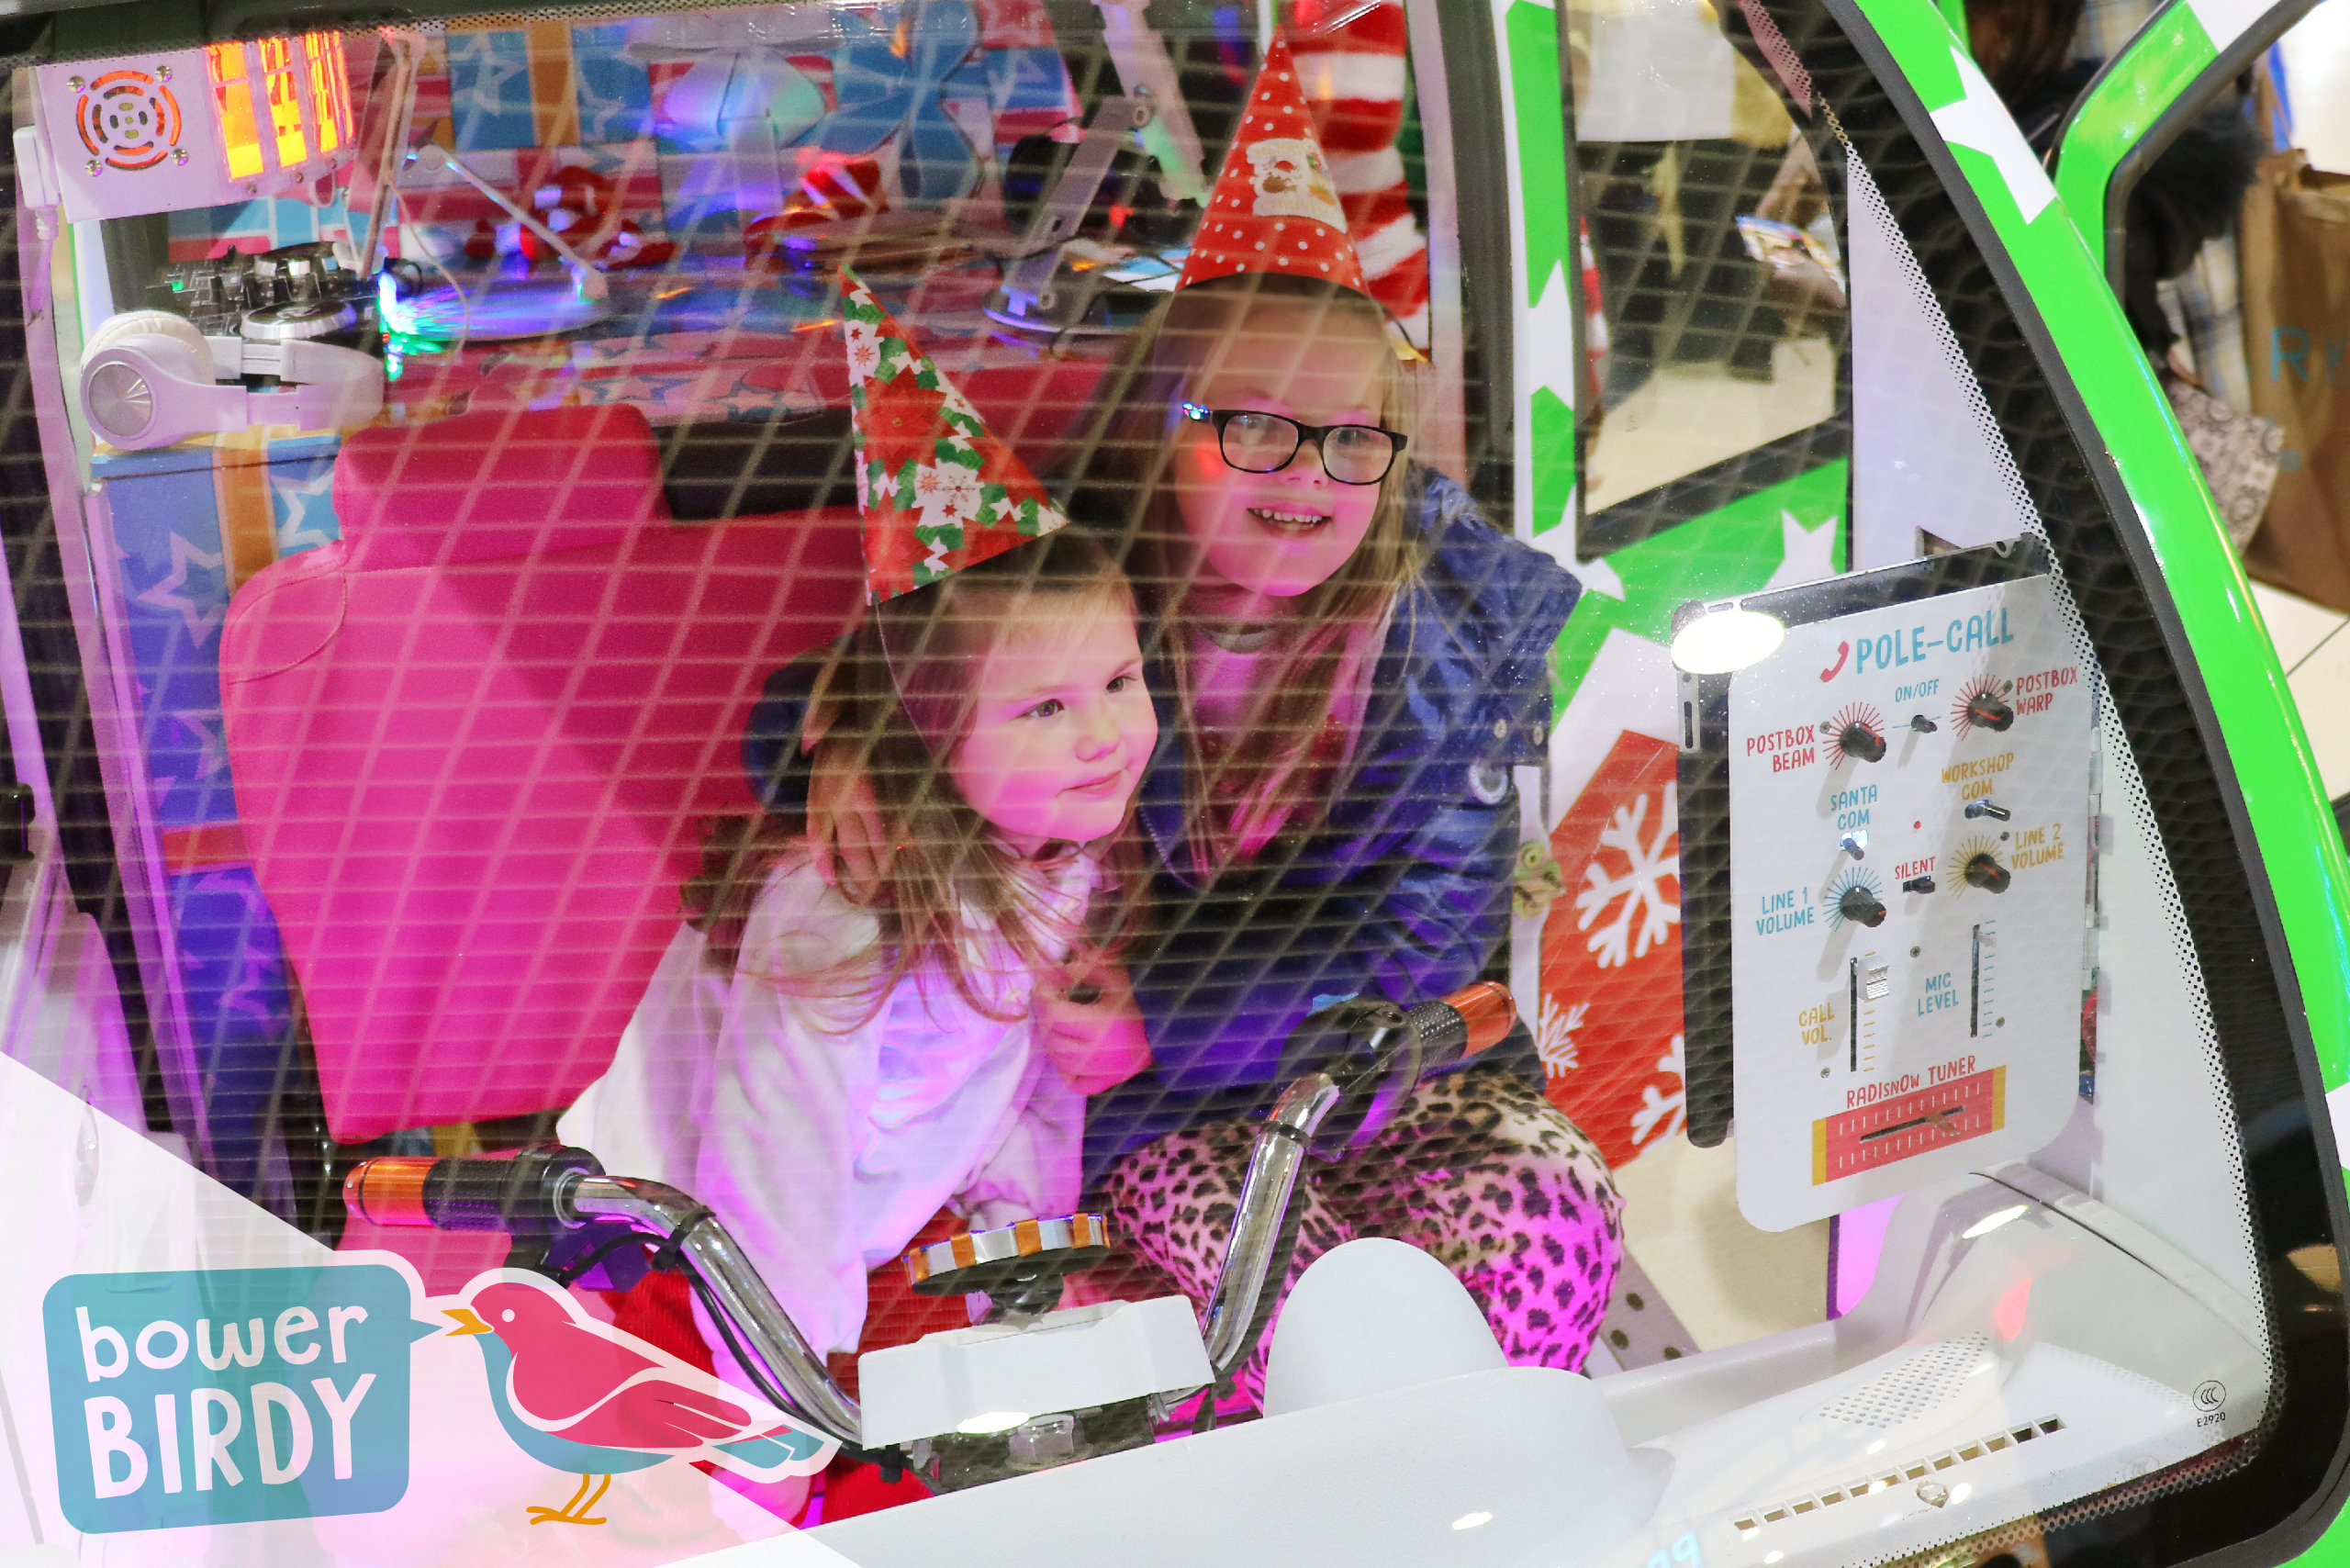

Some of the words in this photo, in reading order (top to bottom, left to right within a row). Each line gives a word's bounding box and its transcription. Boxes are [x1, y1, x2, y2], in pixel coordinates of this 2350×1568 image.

[1856, 607, 2014, 674] POLE-CALL
[1895, 678, 1940, 702] ON/OFF
[2016, 666, 2077, 695] POSTBOX
[2016, 692, 2053, 715] WARP
[1747, 724, 1815, 756] POSTBOX
[1773, 747, 1815, 773] BEAM
[1942, 752, 2015, 783] WORKSHOP
[1830, 784, 1877, 812] SANTA
[1962, 778, 1993, 801] COM
[1837, 808, 1870, 830] COM
[2015, 826, 2046, 851] LINE
[2052, 823, 2062, 841] 2
[1895, 857, 1936, 879] SILENT
[2011, 842, 2065, 869] VOLUME
[1762, 890, 1795, 914] LINE
[1802, 887, 1808, 904] 1
[1756, 907, 1815, 935] VOLUME
[1926, 973, 1952, 992] MIC
[1798, 1002, 1835, 1027] CALL
[1918, 990, 1959, 1016] LEVEL
[1802, 1028, 1832, 1046] VOL.
[1928, 1055, 1975, 1084] TUNER
[2197, 1412, 2226, 1428] E2920
